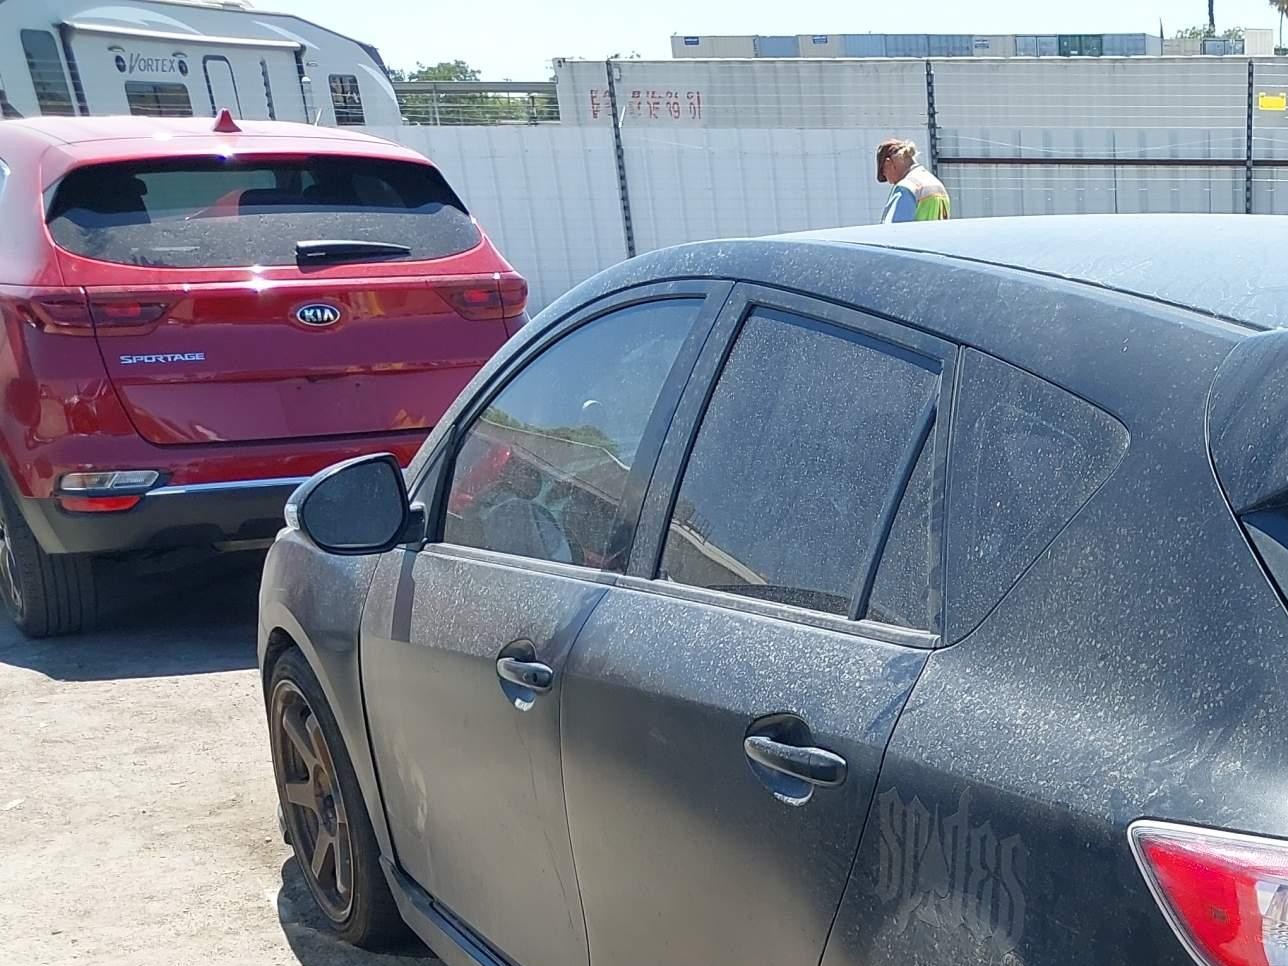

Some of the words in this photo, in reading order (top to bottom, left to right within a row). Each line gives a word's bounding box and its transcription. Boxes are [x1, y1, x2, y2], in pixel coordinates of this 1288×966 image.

[128, 53, 176, 74] VORTEX
[304, 308, 336, 322] KIA
[119, 352, 206, 364] SPORTAGE
